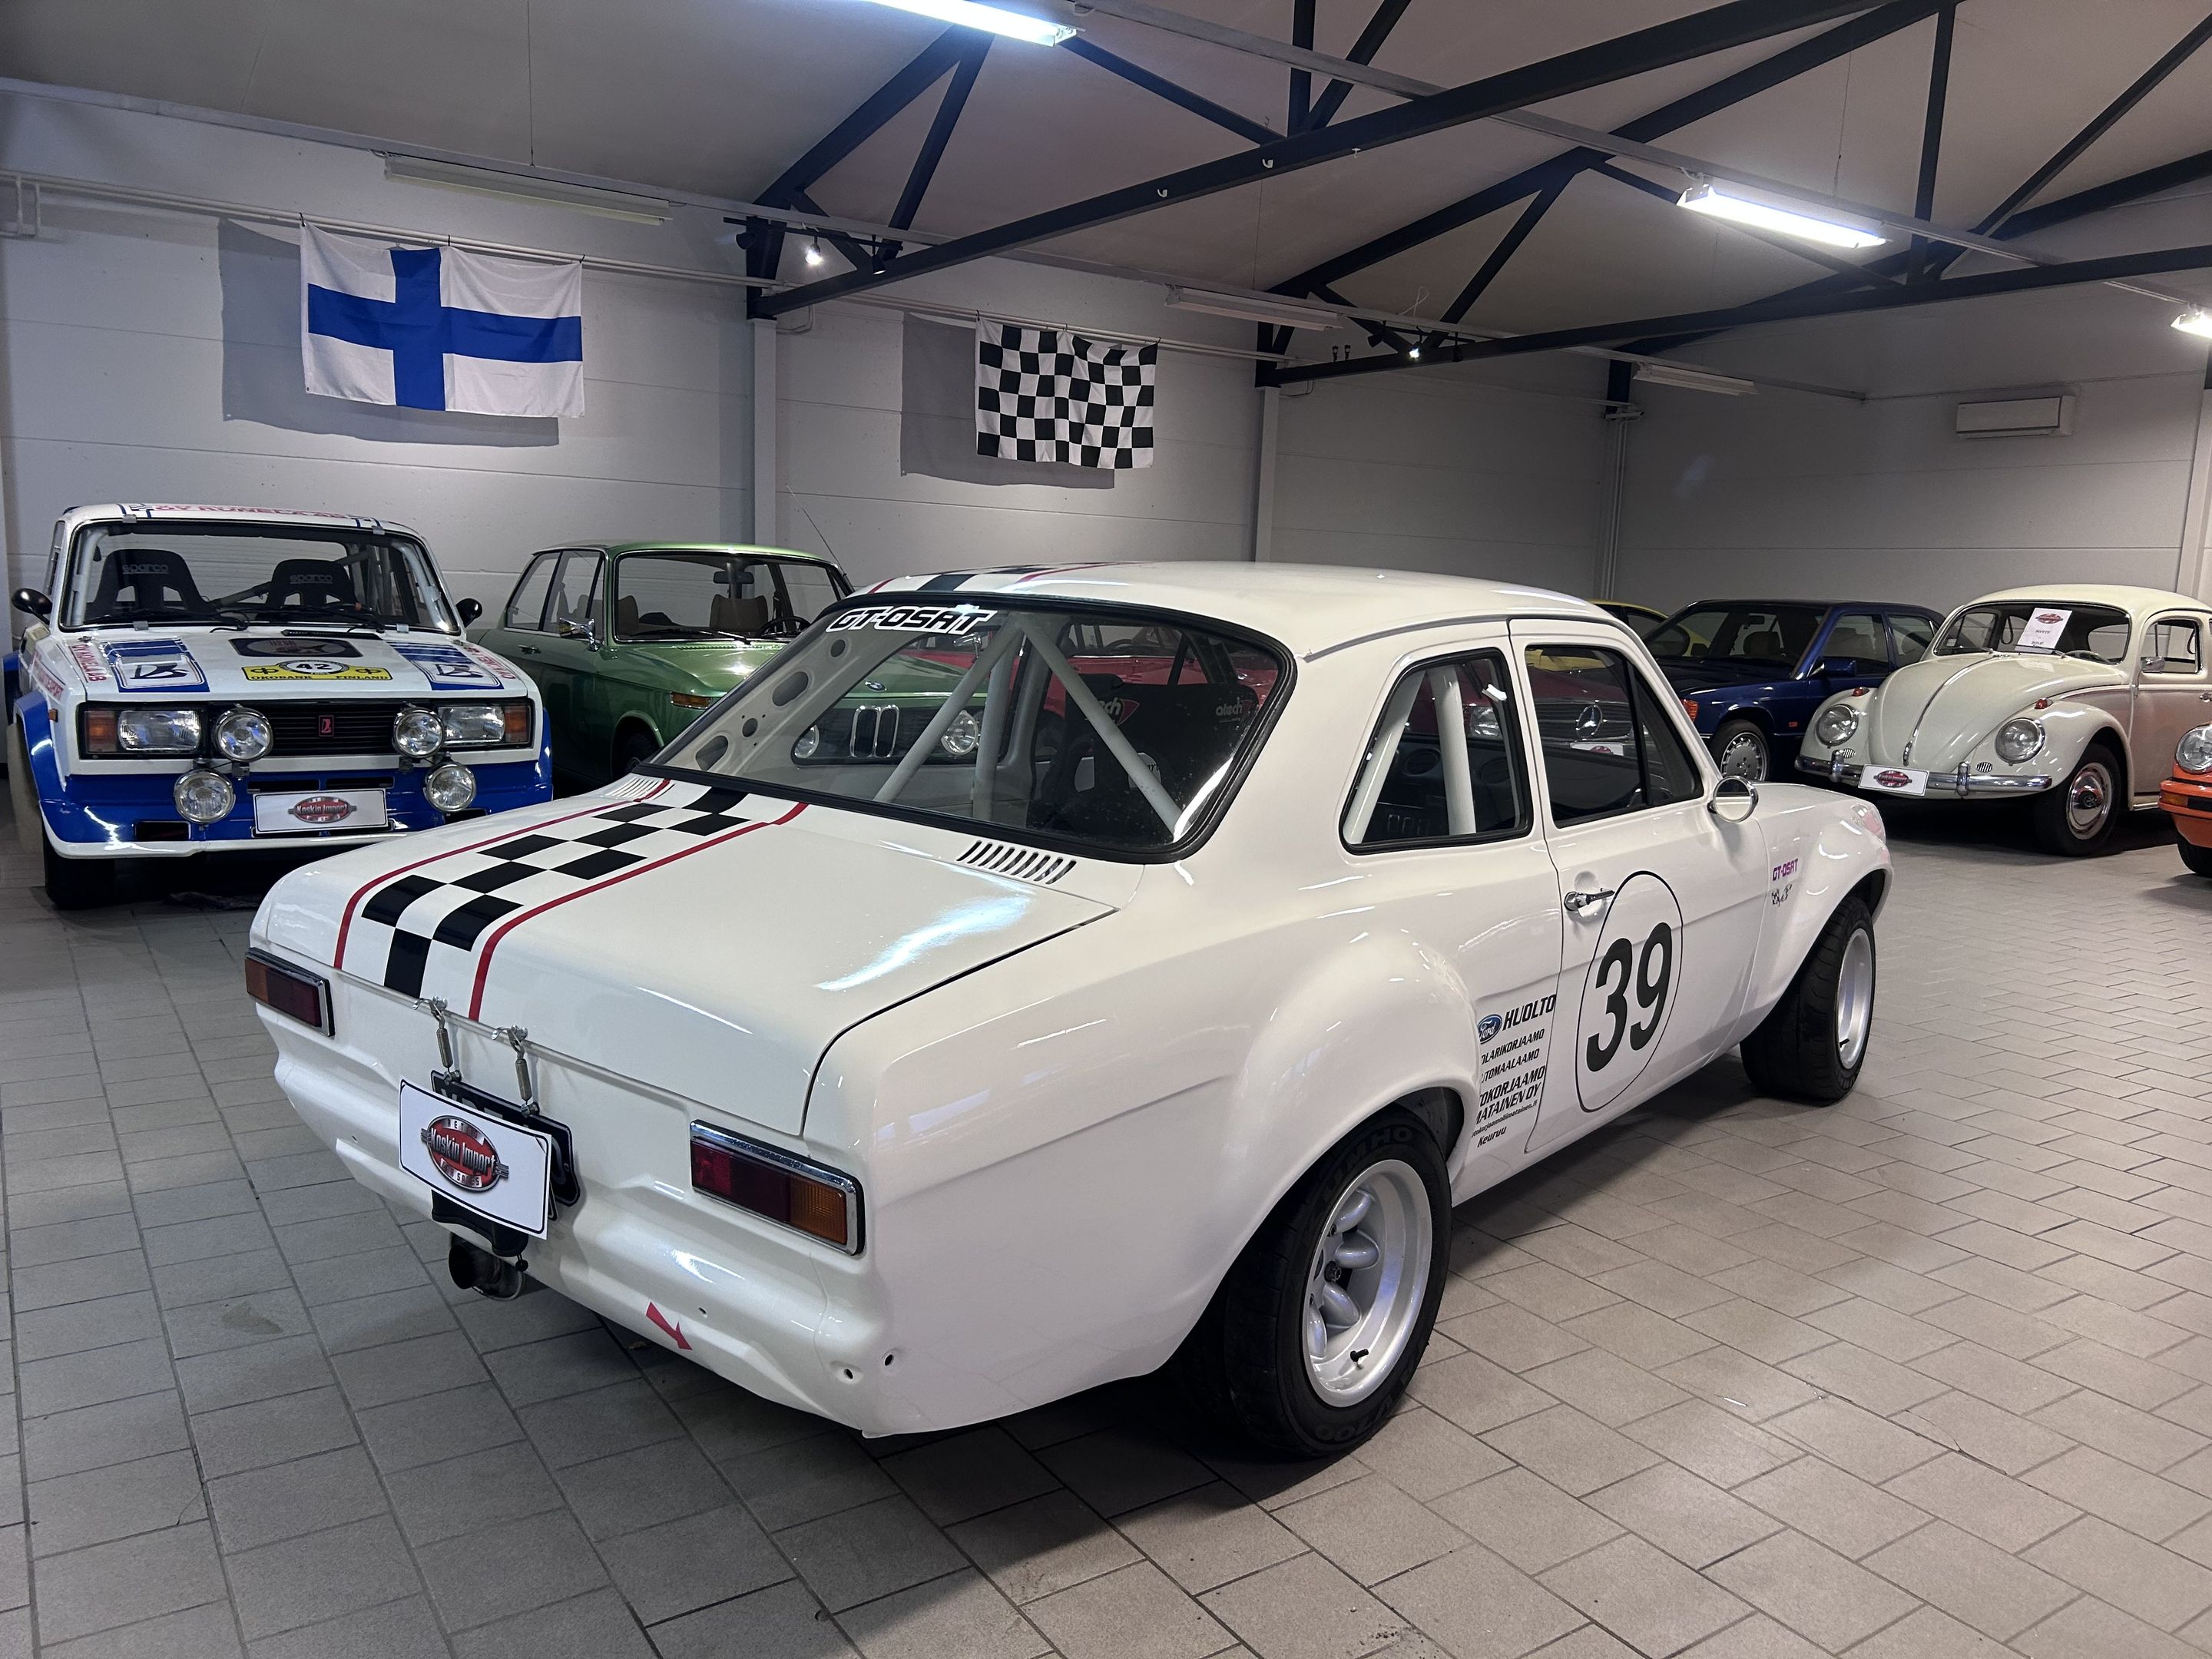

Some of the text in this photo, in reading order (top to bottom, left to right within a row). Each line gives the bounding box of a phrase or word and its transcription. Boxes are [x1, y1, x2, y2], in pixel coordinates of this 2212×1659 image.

[122, 563, 169, 575] sparco
[290, 574, 333, 584] sparco
[826, 605, 998, 634] GT-OSAT
[1773, 858, 1798, 881] GT-OSAT
[1586, 922, 1672, 1072] 39
[1502, 994, 1557, 1031] HUOLTO
[1525, 1081, 1542, 1100] OY
[1477, 1126, 1508, 1148] Keuruu
[430, 1127, 496, 1177] Koskin Import
